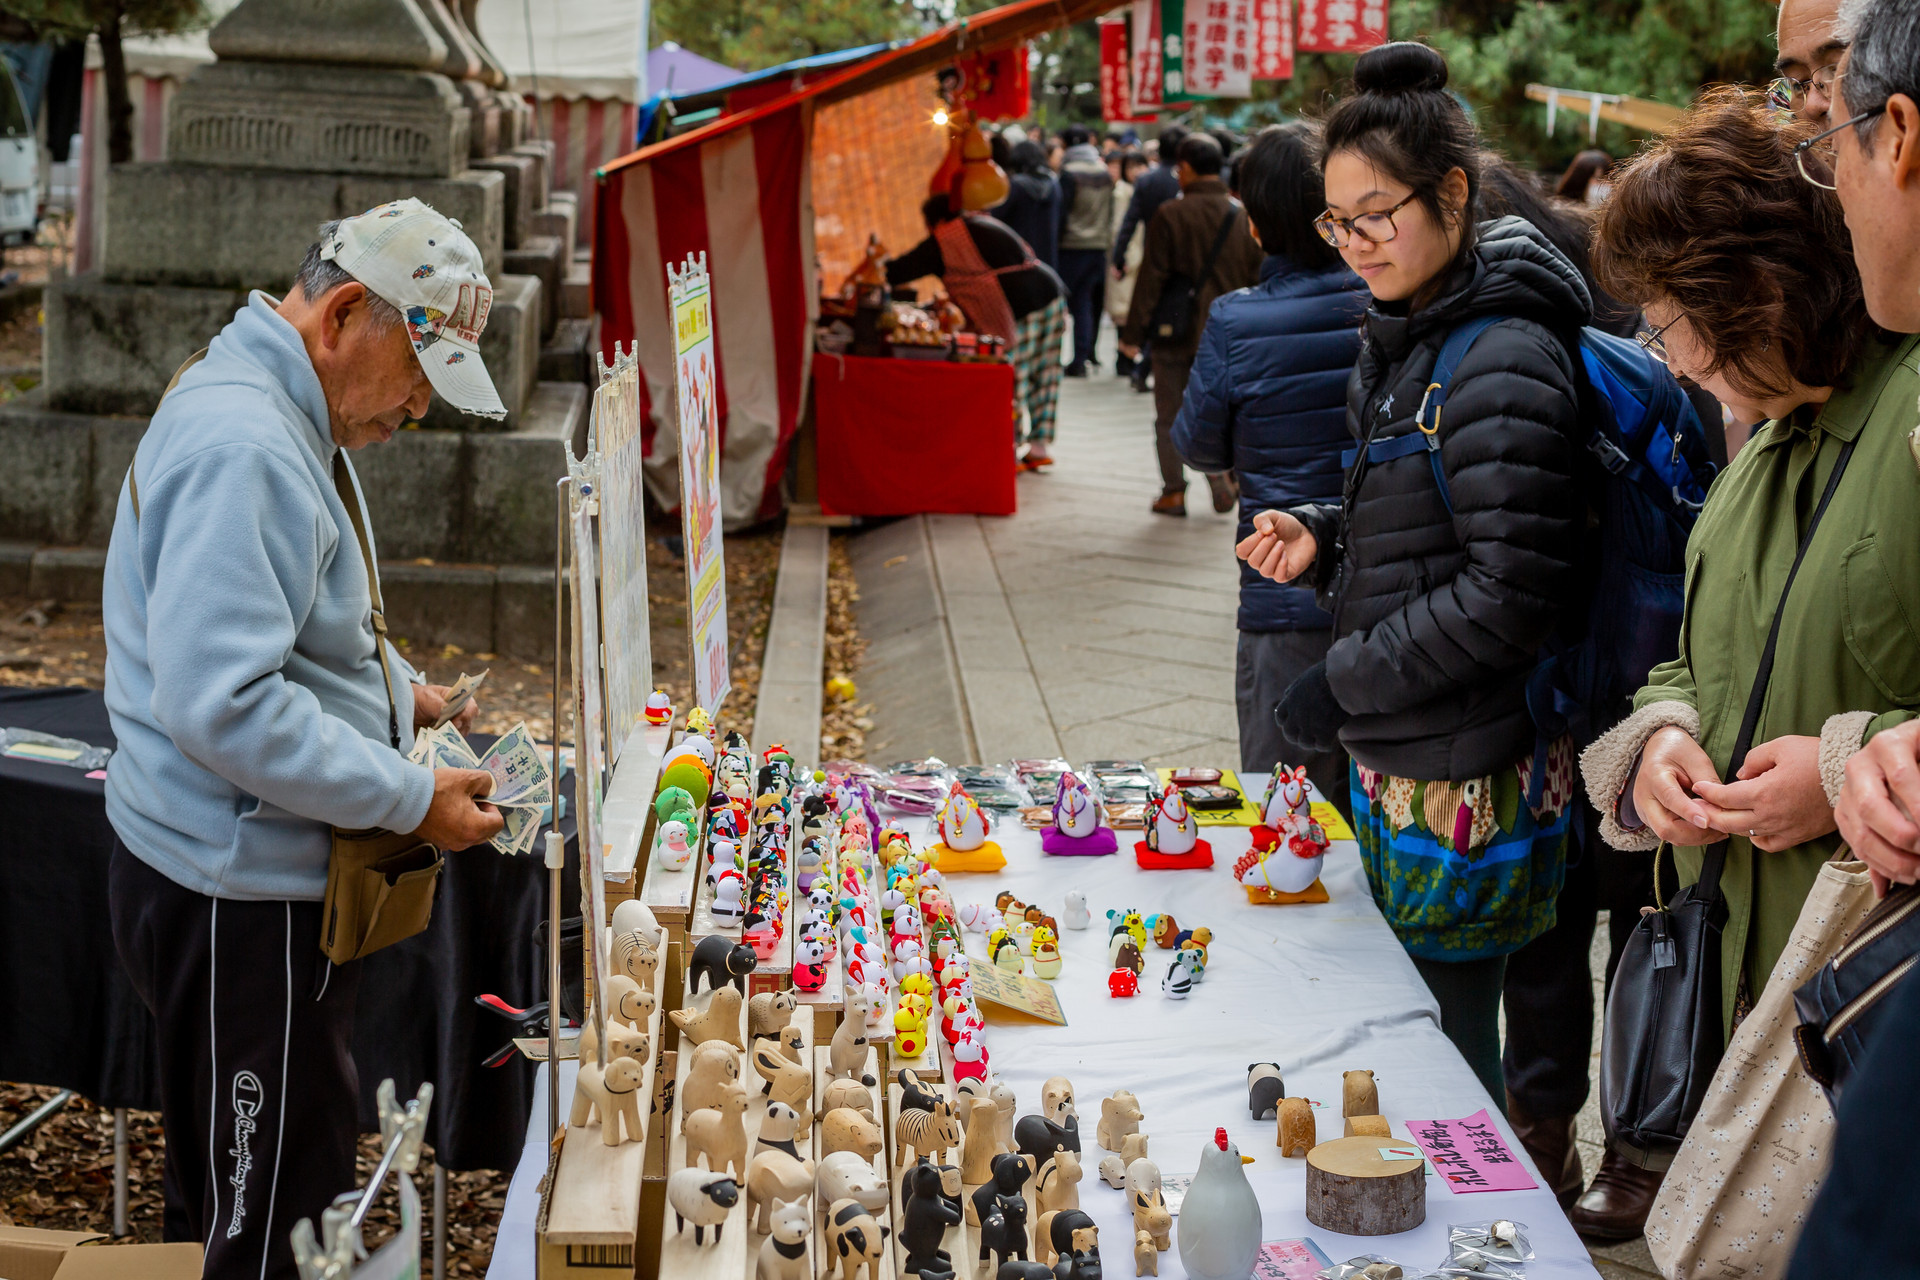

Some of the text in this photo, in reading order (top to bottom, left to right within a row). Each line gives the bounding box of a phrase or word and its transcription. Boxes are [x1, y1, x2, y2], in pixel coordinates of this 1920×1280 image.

[531, 770, 548, 785] 1000
[533, 795, 551, 804] 1000
[229, 1116, 257, 1184] Champion
[1458, 1122, 1514, 1164] 出来るまで
[1770, 1137, 1802, 1160] Sunny
[1773, 1151, 1798, 1166] place
